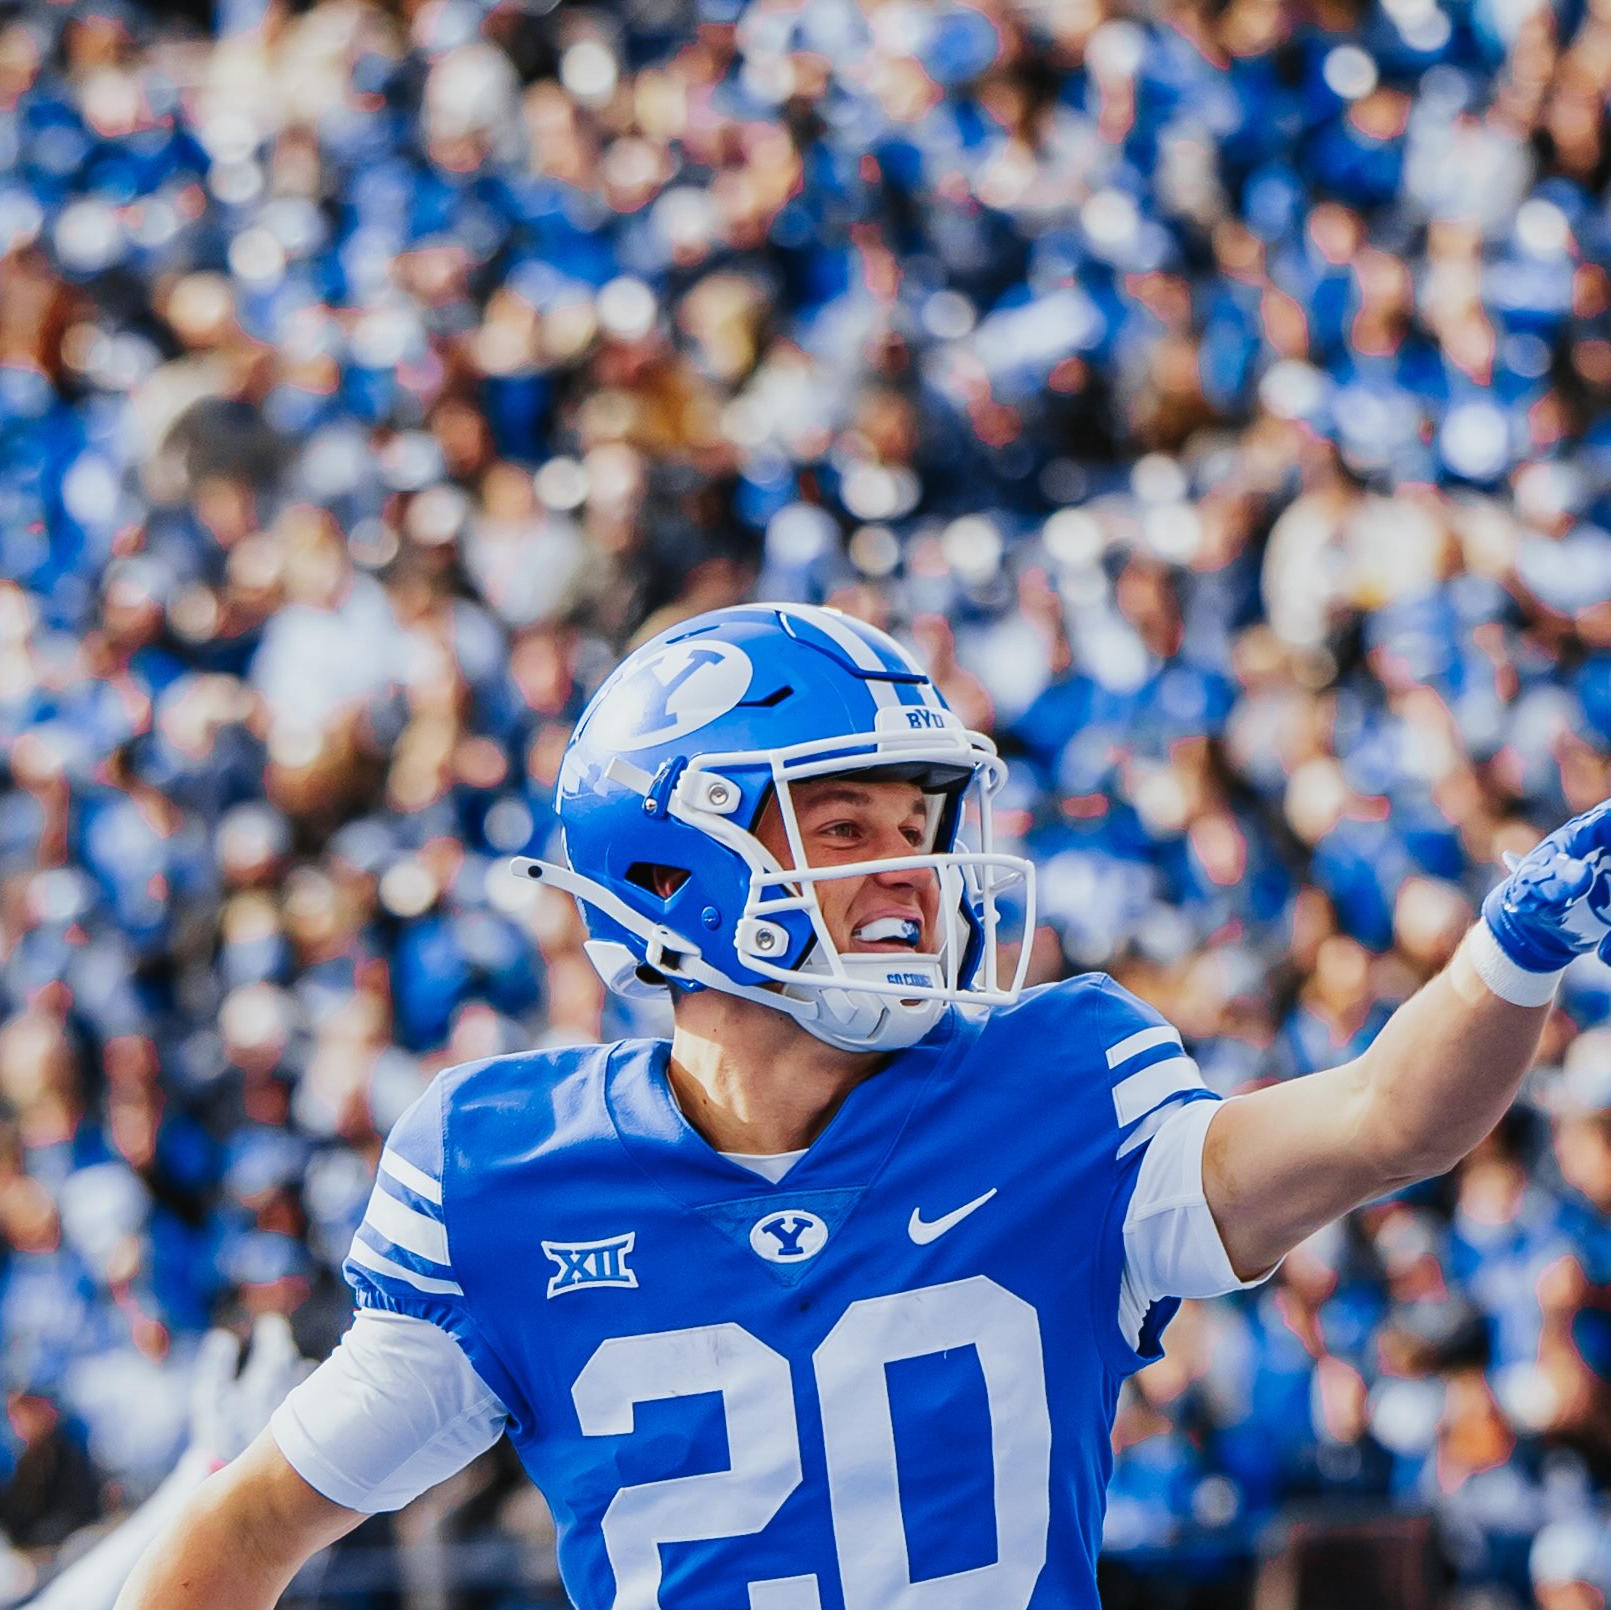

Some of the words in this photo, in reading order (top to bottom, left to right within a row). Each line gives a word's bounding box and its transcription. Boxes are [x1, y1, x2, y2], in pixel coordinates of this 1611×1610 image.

[626, 648, 726, 738] Y
[906, 709, 944, 729] BYU
[761, 1216, 814, 1256] Y
[545, 1238, 632, 1291] XII
